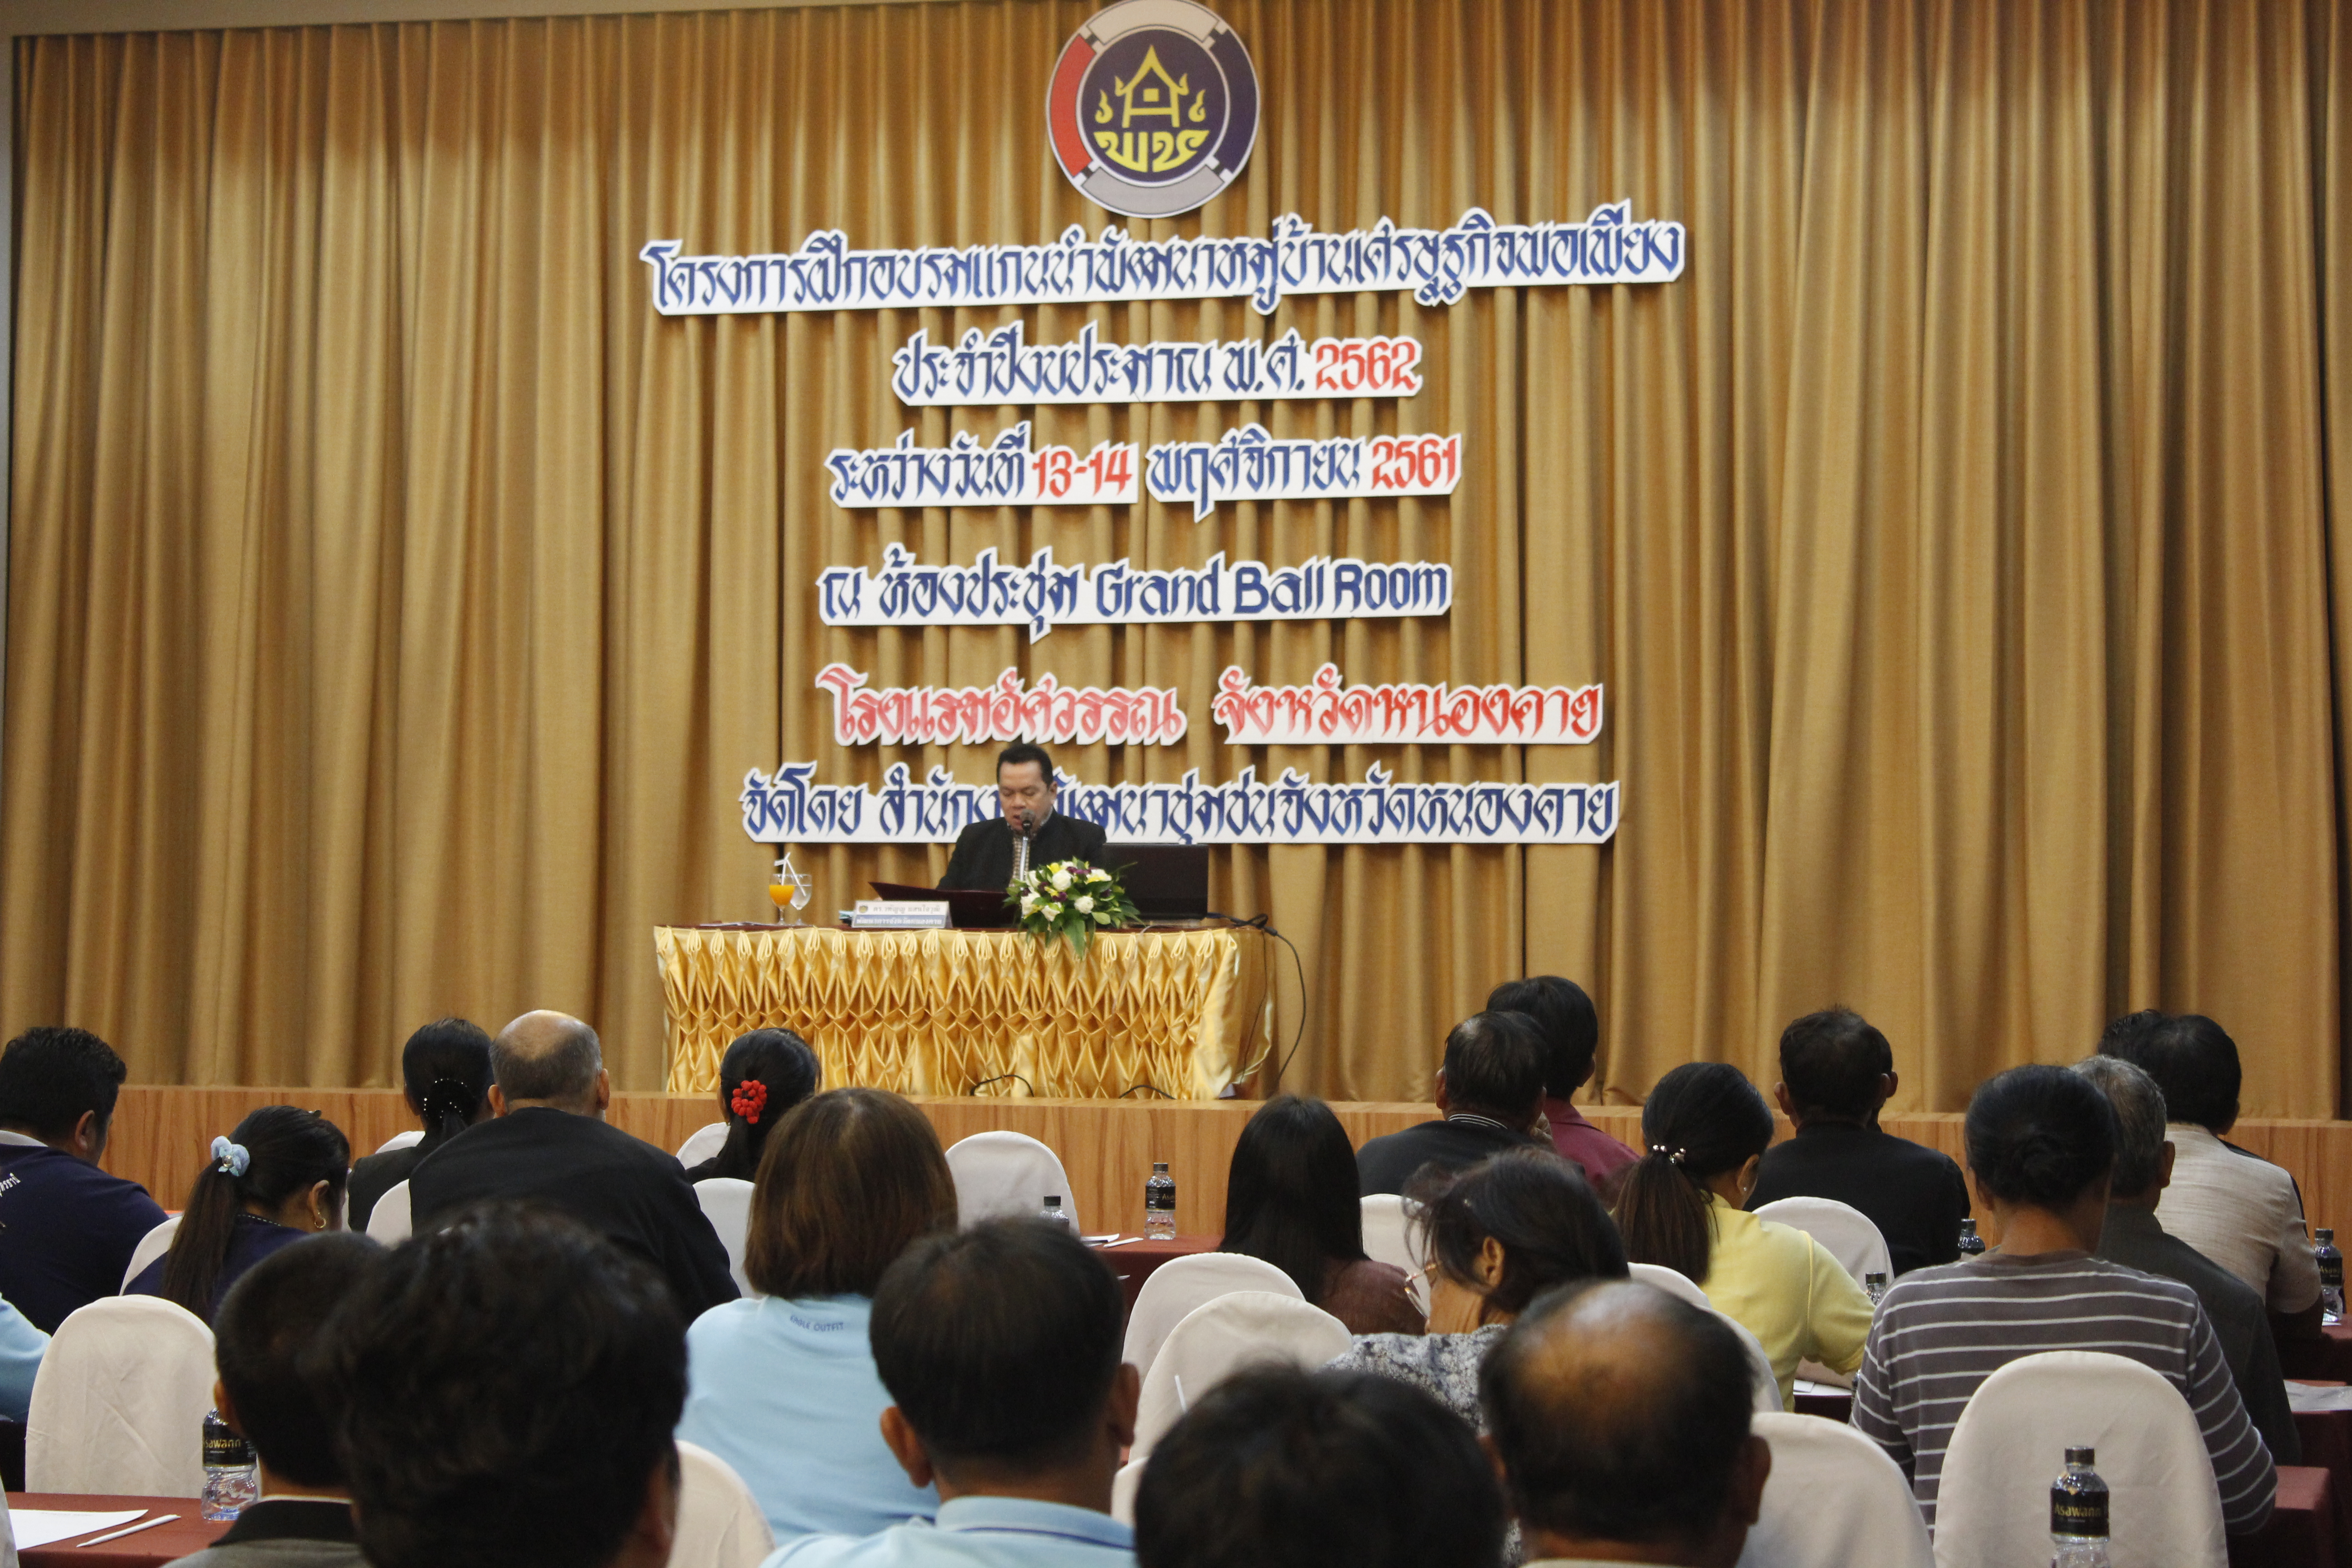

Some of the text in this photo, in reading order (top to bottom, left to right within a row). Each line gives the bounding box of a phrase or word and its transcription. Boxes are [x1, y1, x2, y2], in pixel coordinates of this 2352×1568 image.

[646, 206, 1680, 309] โครงการฝึกอบรมแกนนำพัฒนาหมู่บ้านเศรษฐกิจพอเพียง
[898, 326, 1421, 398] ประจำปีงบประมาณ พ.ศ. 2562
[830, 424, 1457, 515] ระหว่างวันที่ 13-14 พฤศจิกายน 2561
[823, 548, 1447, 633] ณ ห้องประชุม Grand Ball Room
[820, 667, 1599, 740] โรงแรมอัศวรรณ จังหวัดหนองคาย
[745, 767, 863, 836] จัดโดย
[813, 1321, 844, 1332] OUTFIT
